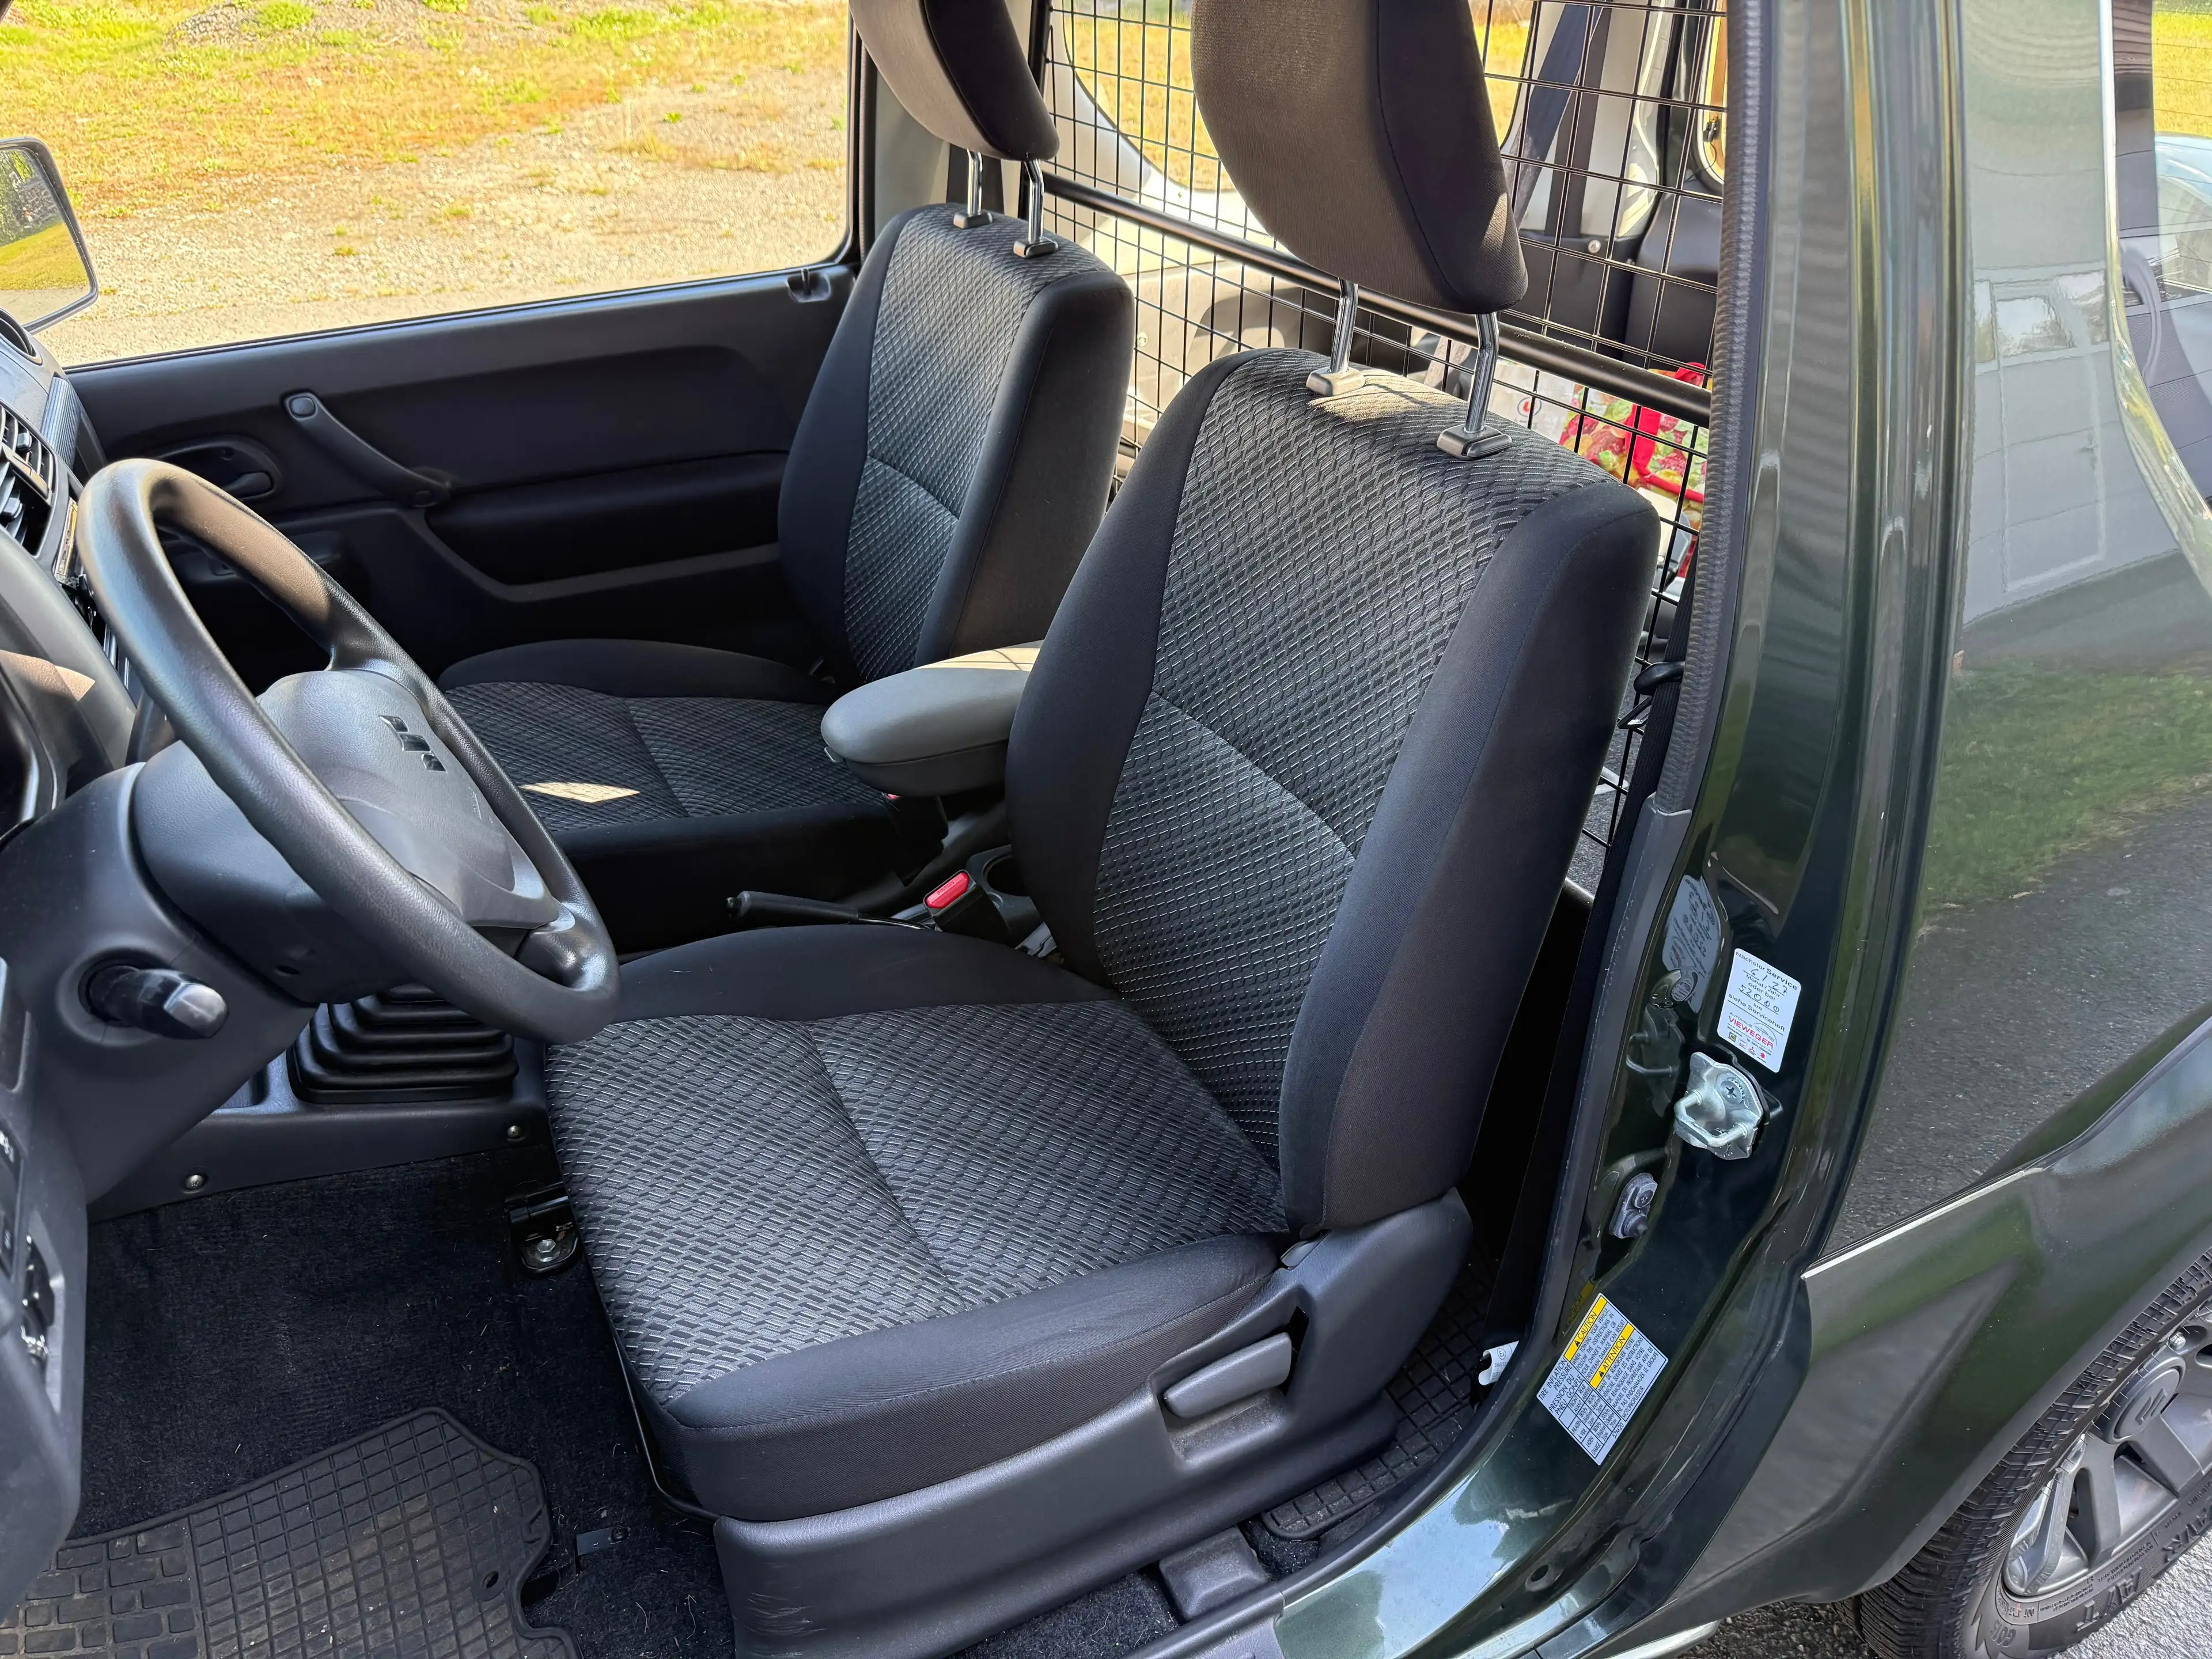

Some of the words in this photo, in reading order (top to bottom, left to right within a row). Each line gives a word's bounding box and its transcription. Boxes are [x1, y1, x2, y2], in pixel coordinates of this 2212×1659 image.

[1736, 950, 1765, 971] Nächster
[1766, 967, 1798, 991] Service
[1745, 974, 1763, 988] Monat
[1767, 987, 1780, 998] Jahr
[1748, 981, 1764, 994] oder
[1764, 991, 1775, 1001] bei
[1753, 1002, 1762, 1011] km
[1728, 993, 1747, 1007] siehe
[1747, 1004, 1786, 1032] Serviceheft
[1729, 1011, 1752, 1028] AUTOHAUS
[1728, 1015, 1774, 1050] VIEWEGER
[1577, 1310, 1597, 1340] CAUTION
[1571, 1352, 1581, 1366] WHEN
[1579, 1335, 1592, 1353] TOWING
[1590, 1323, 1599, 1336] YOUR
[1576, 1354, 1588, 1371] FOLLOW
[1591, 1318, 1610, 1346] INSTRUCTIONS
[1581, 1363, 1590, 1376] YOUR
[1599, 1327, 1612, 1346] MANUAL
[1609, 1320, 1616, 1329] OR
[1585, 1358, 1601, 1381] DRIVETRAIN
[1598, 1340, 1611, 1359] DAMAGE
[1609, 1331, 1618, 1343] CAN
[1601, 1335, 1626, 1370] ATTENTION
[1612, 1367, 1623, 1382] SUIVEZ
[1625, 1335, 1643, 1362] INSTRUCTIONS
[1538, 1387, 1548, 1401] TIRE
[1546, 1357, 1567, 1389] INFLATION
[1553, 1362, 1572, 1391] PRESSURE
[1597, 1379, 1608, 1393] AVANT
[1605, 1372, 1612, 1380] DE
[1609, 1350, 1626, 1374] REMORQUER
[1624, 1336, 1635, 1351] VOTRE
[1607, 1395, 1613, 1403] DE
[1611, 1370, 1629, 1397] REMORQUAGE
[1627, 1359, 1637, 1372] DANS
[1634, 1346, 1645, 1361] VOTRE
[1612, 1392, 1624, 1408] MANUEL
[1622, 1385, 1628, 1393] DU
[1641, 1351, 1650, 1363] AFIN
[1616, 1406, 1623, 1414] NE
[1625, 1371, 1645, 1400] ENDOMMAGER
[1646, 1350, 1658, 1368] GROUPE
[1548, 1384, 1568, 1413] PRESSION
[1566, 1373, 1574, 1385] DU
[1569, 1395, 1579, 1409] FRONT
[1573, 1399, 1583, 1413] AVANT
[1577, 1383, 1586, 1395] REAR
[1555, 1398, 1568, 1416] PNEU
[1579, 1427, 1587, 1437] VIDE
[1585, 1434, 1594, 1448] LADEN
[1611, 1421, 1624, 1439] 57M20
